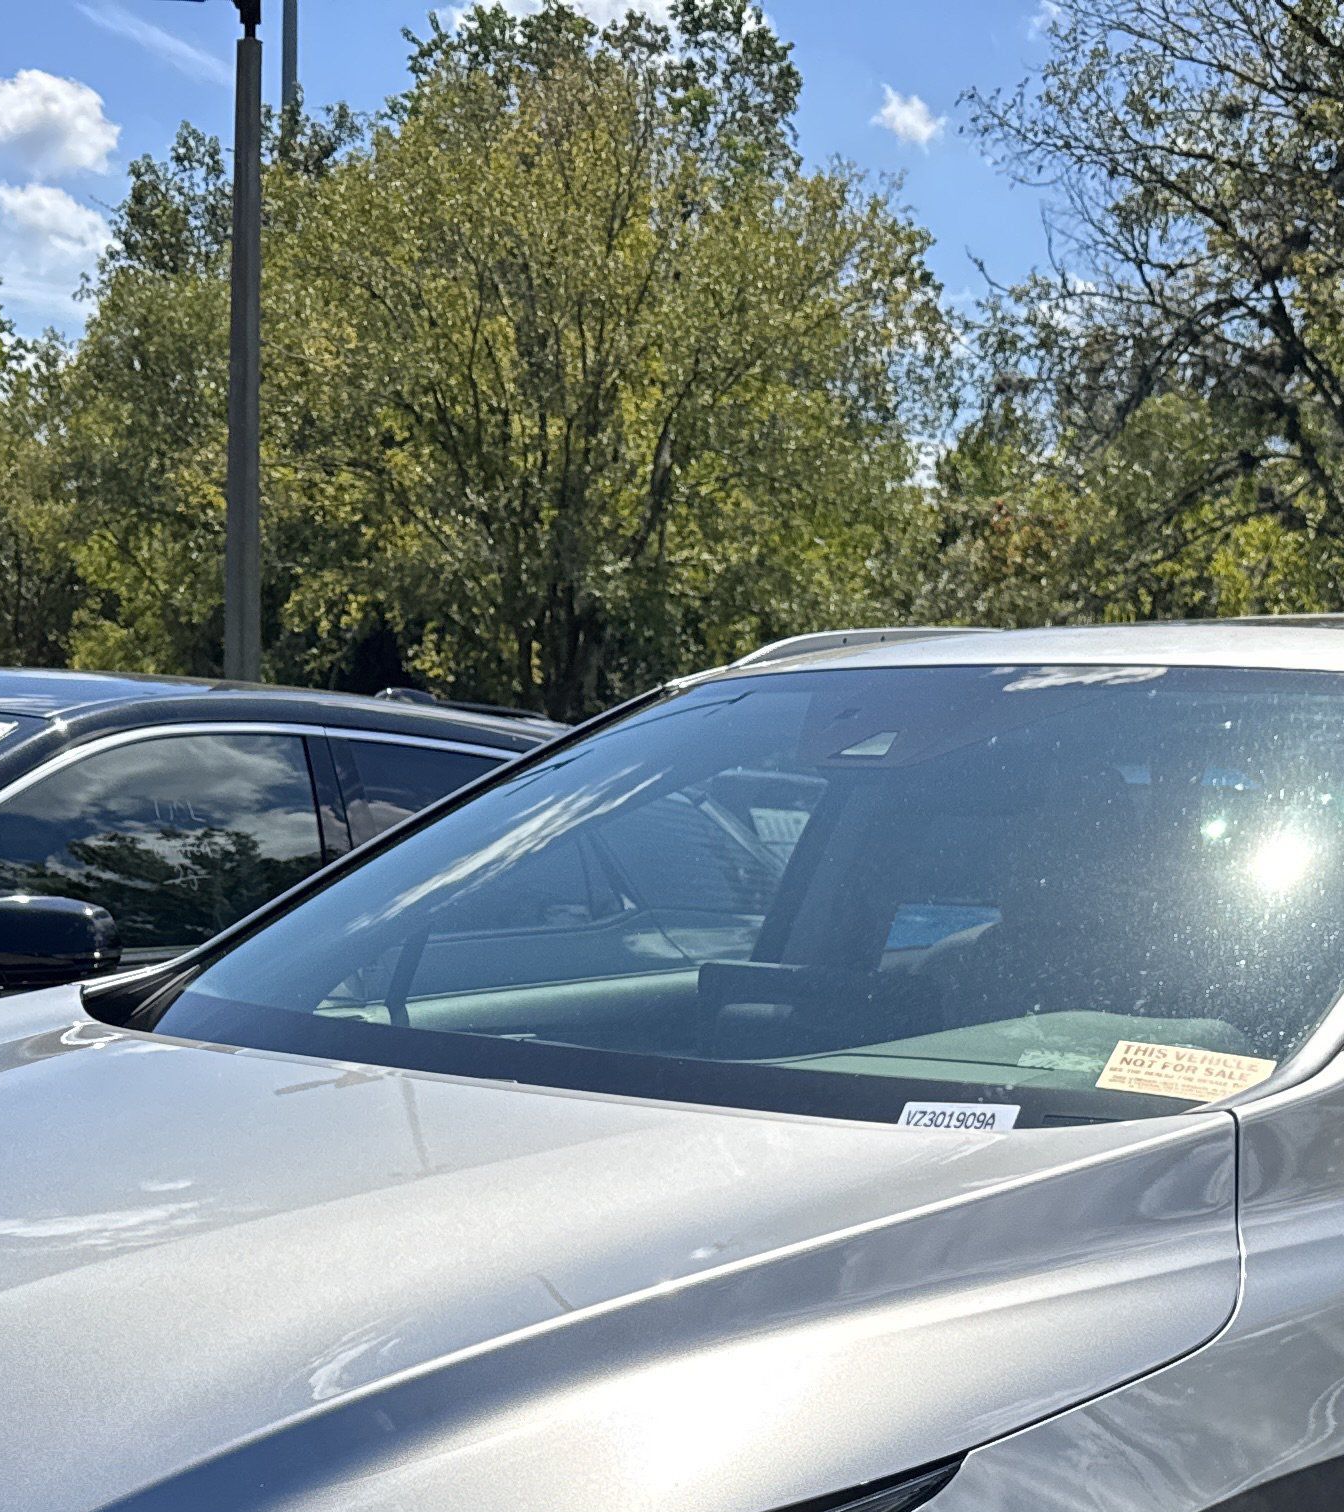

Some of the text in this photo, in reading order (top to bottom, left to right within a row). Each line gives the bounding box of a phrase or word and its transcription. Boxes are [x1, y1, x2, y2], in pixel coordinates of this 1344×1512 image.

[1120, 1056, 1157, 1069] NOT
[1161, 1061, 1198, 1075] FOR
[1203, 1067, 1250, 1083] SALE
[1123, 1044, 1260, 1073] THIS VEHICLE
[905, 1110, 996, 1130] VZ301909A
